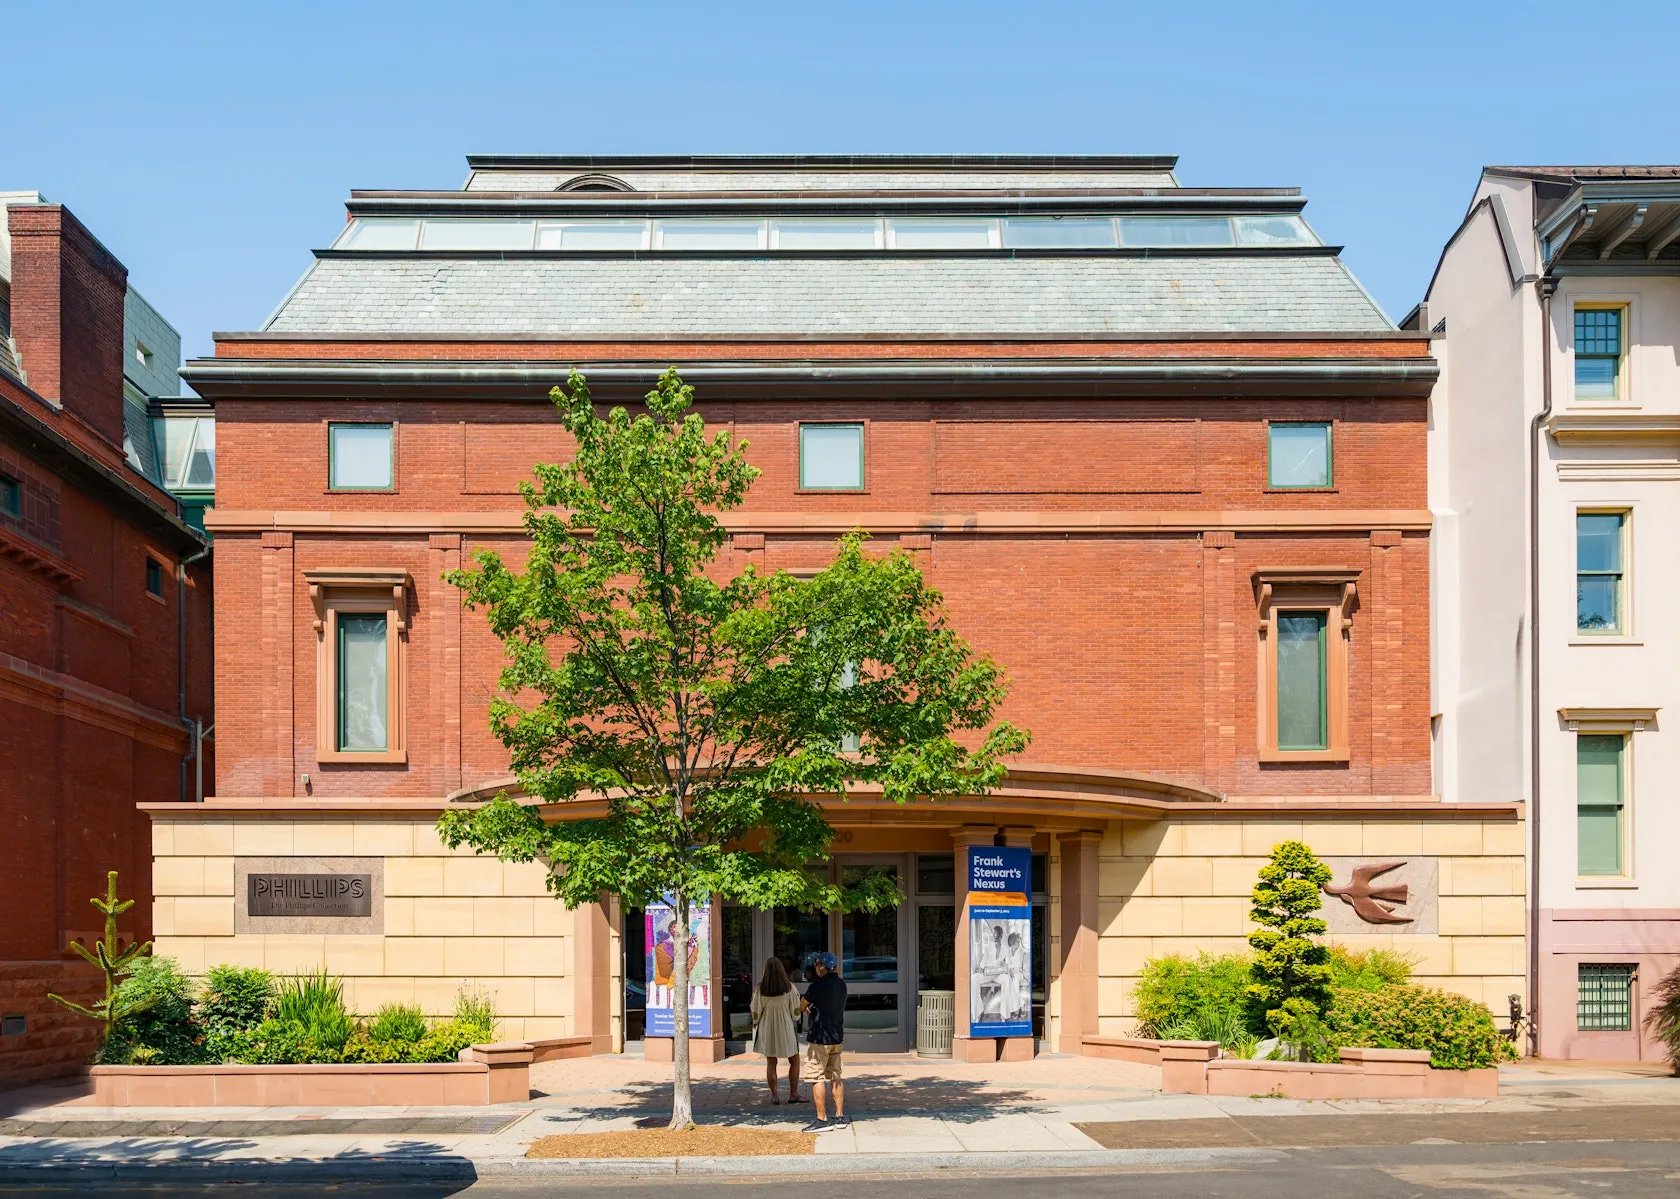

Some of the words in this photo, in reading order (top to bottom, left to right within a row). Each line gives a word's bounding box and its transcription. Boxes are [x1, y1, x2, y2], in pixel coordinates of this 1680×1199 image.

[973, 855, 1004, 867] Frank
[973, 867, 1021, 879] Stewart's
[253, 878, 364, 899] PHILLIPS
[973, 878, 1005, 889] Nexus
[271, 901, 283, 909] The
[285, 901, 312, 911] Phillips
[313, 901, 348, 910] Collection
